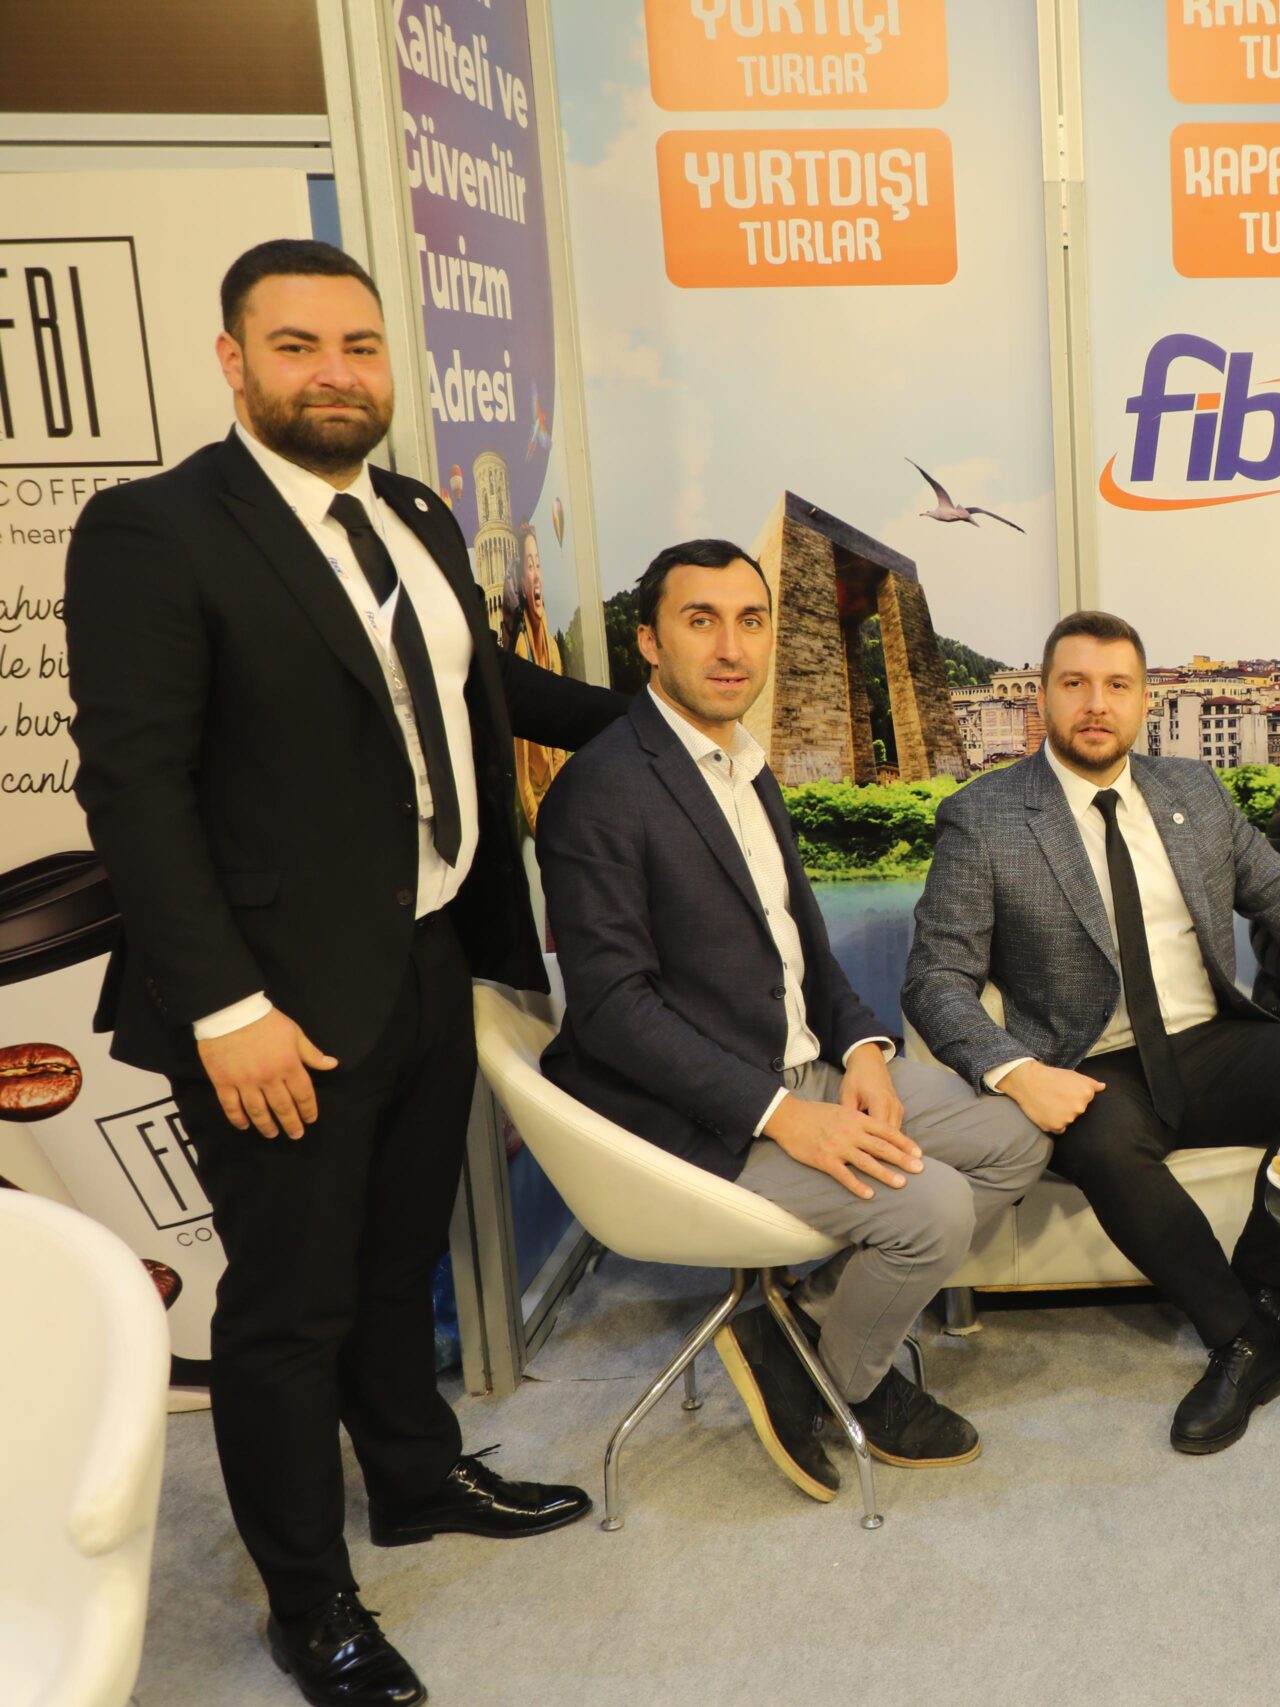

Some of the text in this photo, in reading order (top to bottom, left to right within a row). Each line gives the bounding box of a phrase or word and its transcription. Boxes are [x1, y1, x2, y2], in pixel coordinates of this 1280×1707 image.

[495, 65, 528, 129] ve
[736, 53, 868, 97] TURLAR
[684, 148, 929, 221] YURTDIŞI
[739, 218, 882, 265] TURLAR
[426, 349, 516, 423] Adresi
